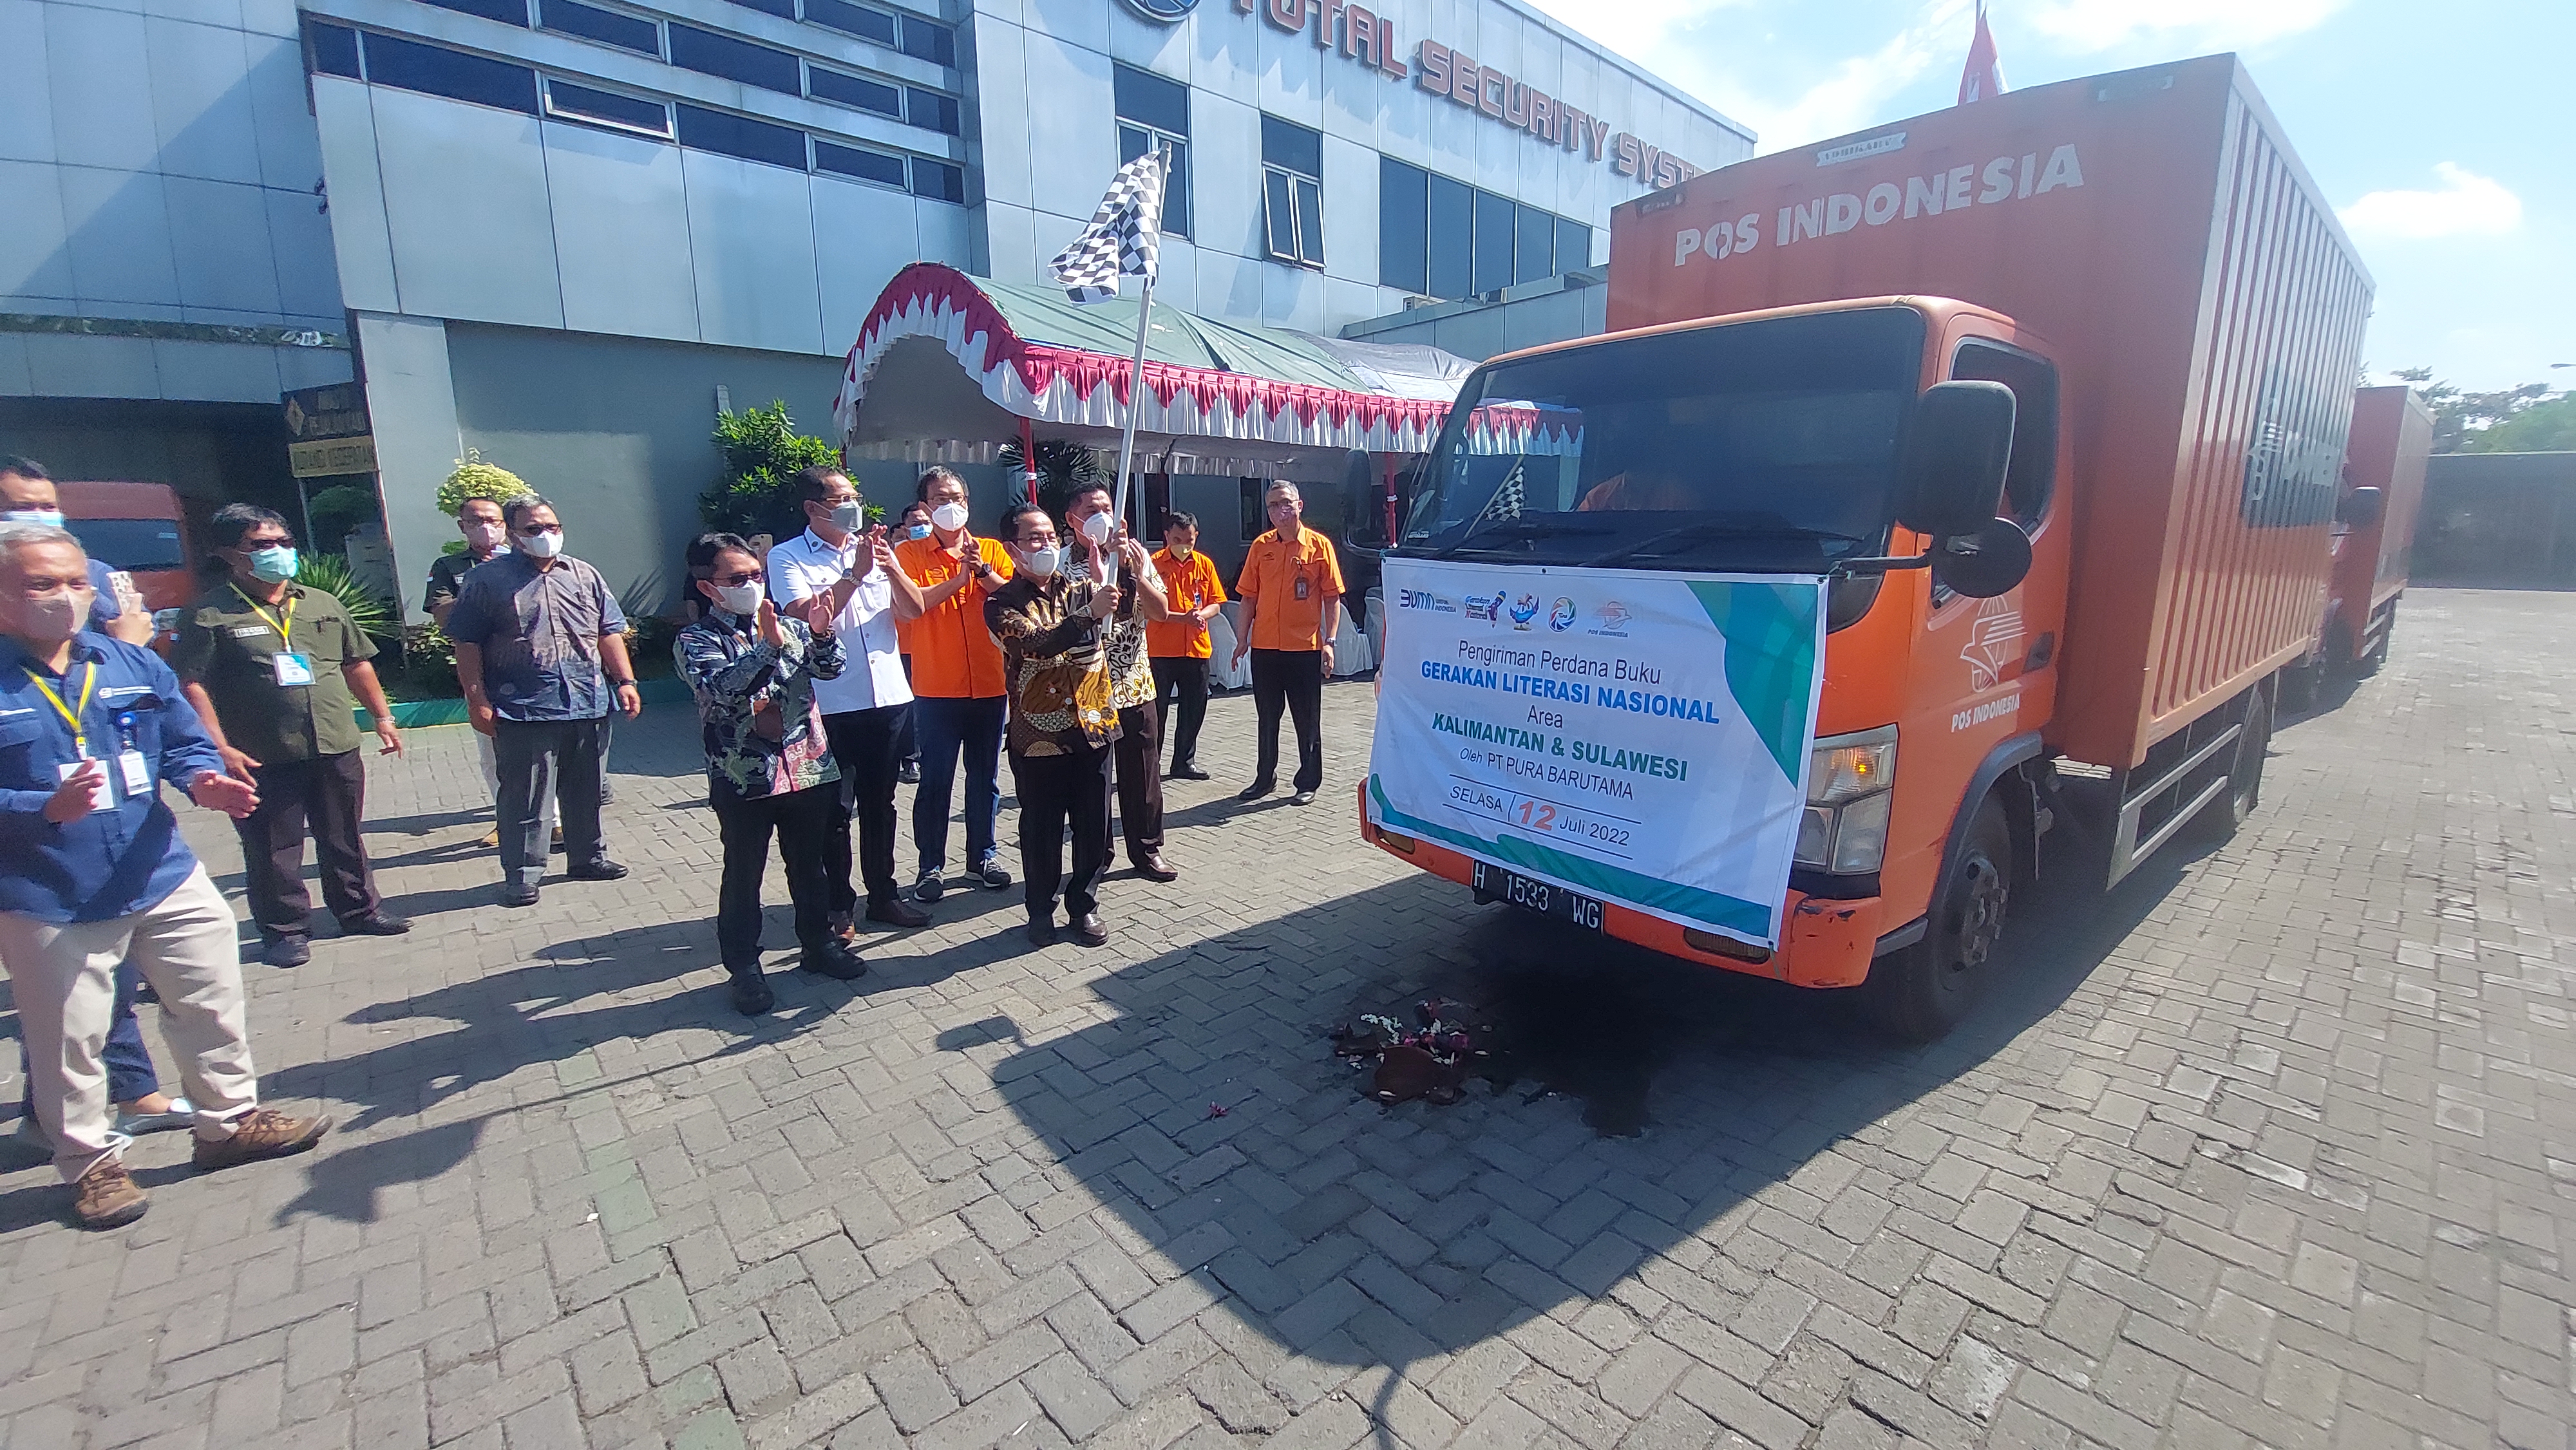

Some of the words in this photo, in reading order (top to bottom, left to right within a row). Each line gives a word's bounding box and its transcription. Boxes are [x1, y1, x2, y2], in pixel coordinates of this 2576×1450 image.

[1419, 39, 1609, 162] SECURITY
[1618, 131, 1707, 188] SYST
[1675, 213, 1759, 267] POS
[1776, 144, 2084, 247] INDONESIA
[1421, 660, 1497, 690] GERAKAN
[1502, 674, 1591, 704] LITERASI
[1598, 686, 1720, 724] NASIONAL
[1458, 640, 1535, 668] Pengiriman
[1540, 650, 1608, 678] Perdana
[1615, 659, 1661, 684] Buku
[1526, 704, 1563, 729] Area
[1951, 709, 1971, 733] POS
[1973, 693, 2020, 725] INDONESIA
[1432, 712, 1544, 753] KALIMANTAN
[1551, 737, 1565, 757] &
[1571, 740, 1687, 781] SULAWESI
[1459, 748, 1482, 764] Oleh
[1488, 752, 1504, 769] PT
[1506, 757, 1544, 780] PURA
[1548, 766, 1633, 800] BARUTAMA
[1450, 786, 1502, 812] SELASA
[1519, 800, 1556, 831] 12
[1559, 815, 1586, 834] Juli
[1589, 823, 1630, 846] 2022
[1473, 862, 1486, 889] H
[1507, 874, 1549, 911] 1533
[1573, 895, 1599, 928] WG
